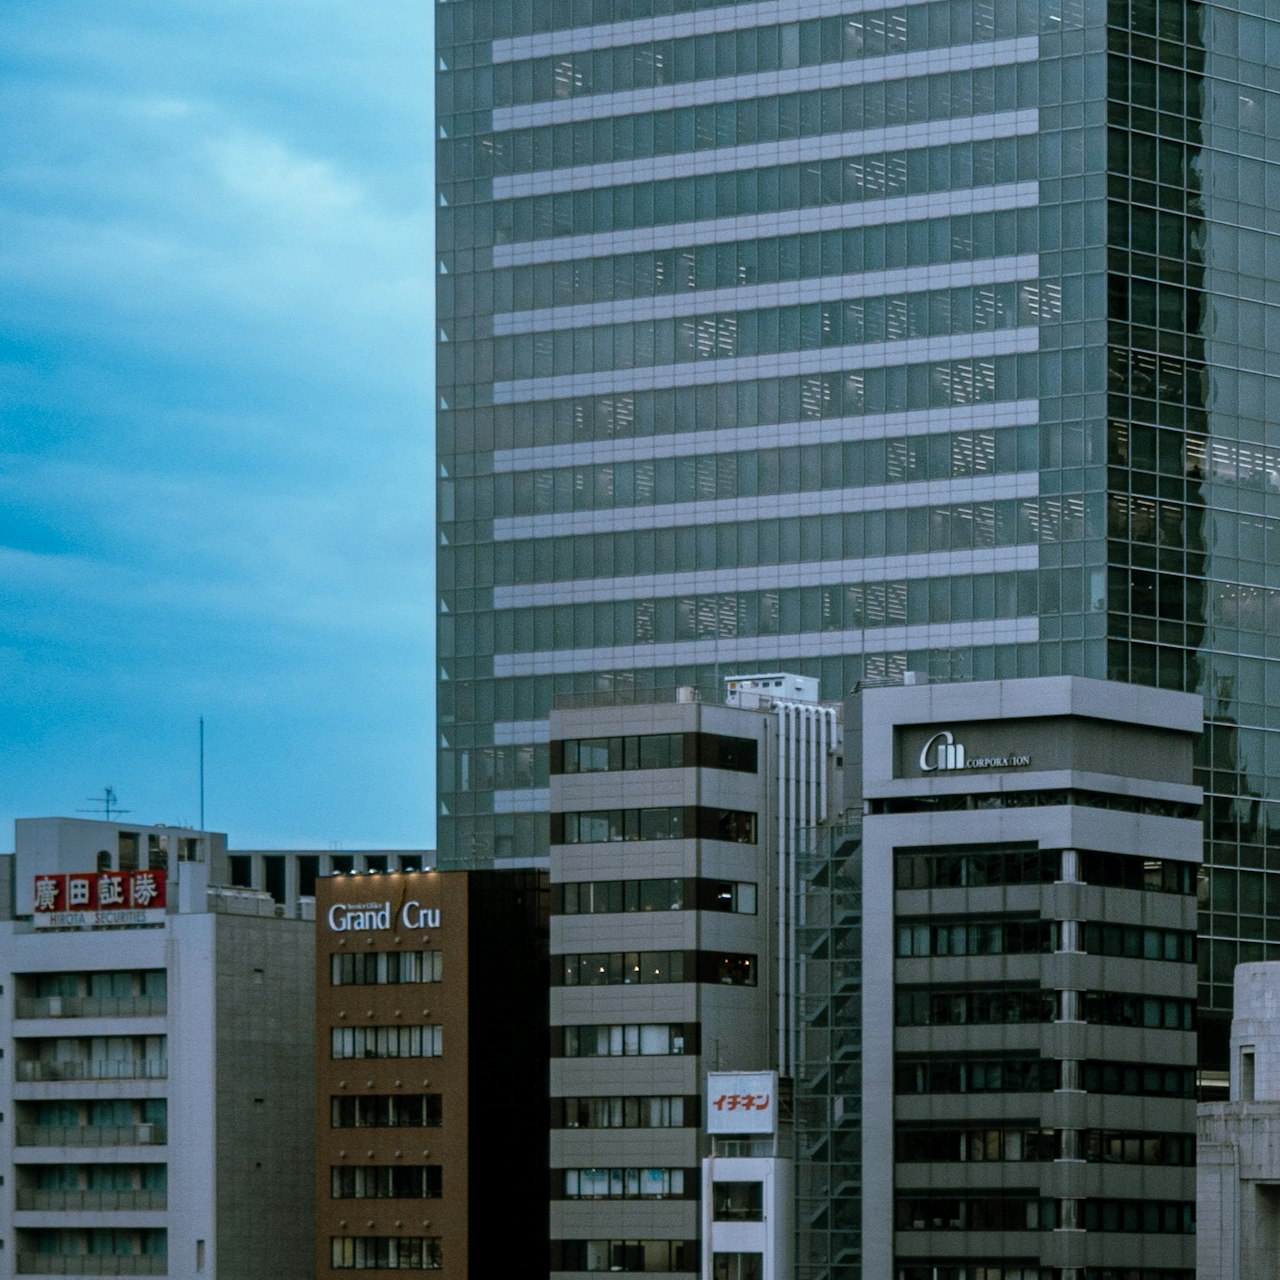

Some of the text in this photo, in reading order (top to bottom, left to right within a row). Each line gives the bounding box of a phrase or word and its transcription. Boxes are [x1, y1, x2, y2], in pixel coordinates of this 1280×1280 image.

[35, 872, 158, 910] 廣田証券
[50, 911, 147, 925] HIROTA SECURITIES
[328, 901, 440, 931] Grand Cru
[713, 1094, 770, 1111] イチネン
